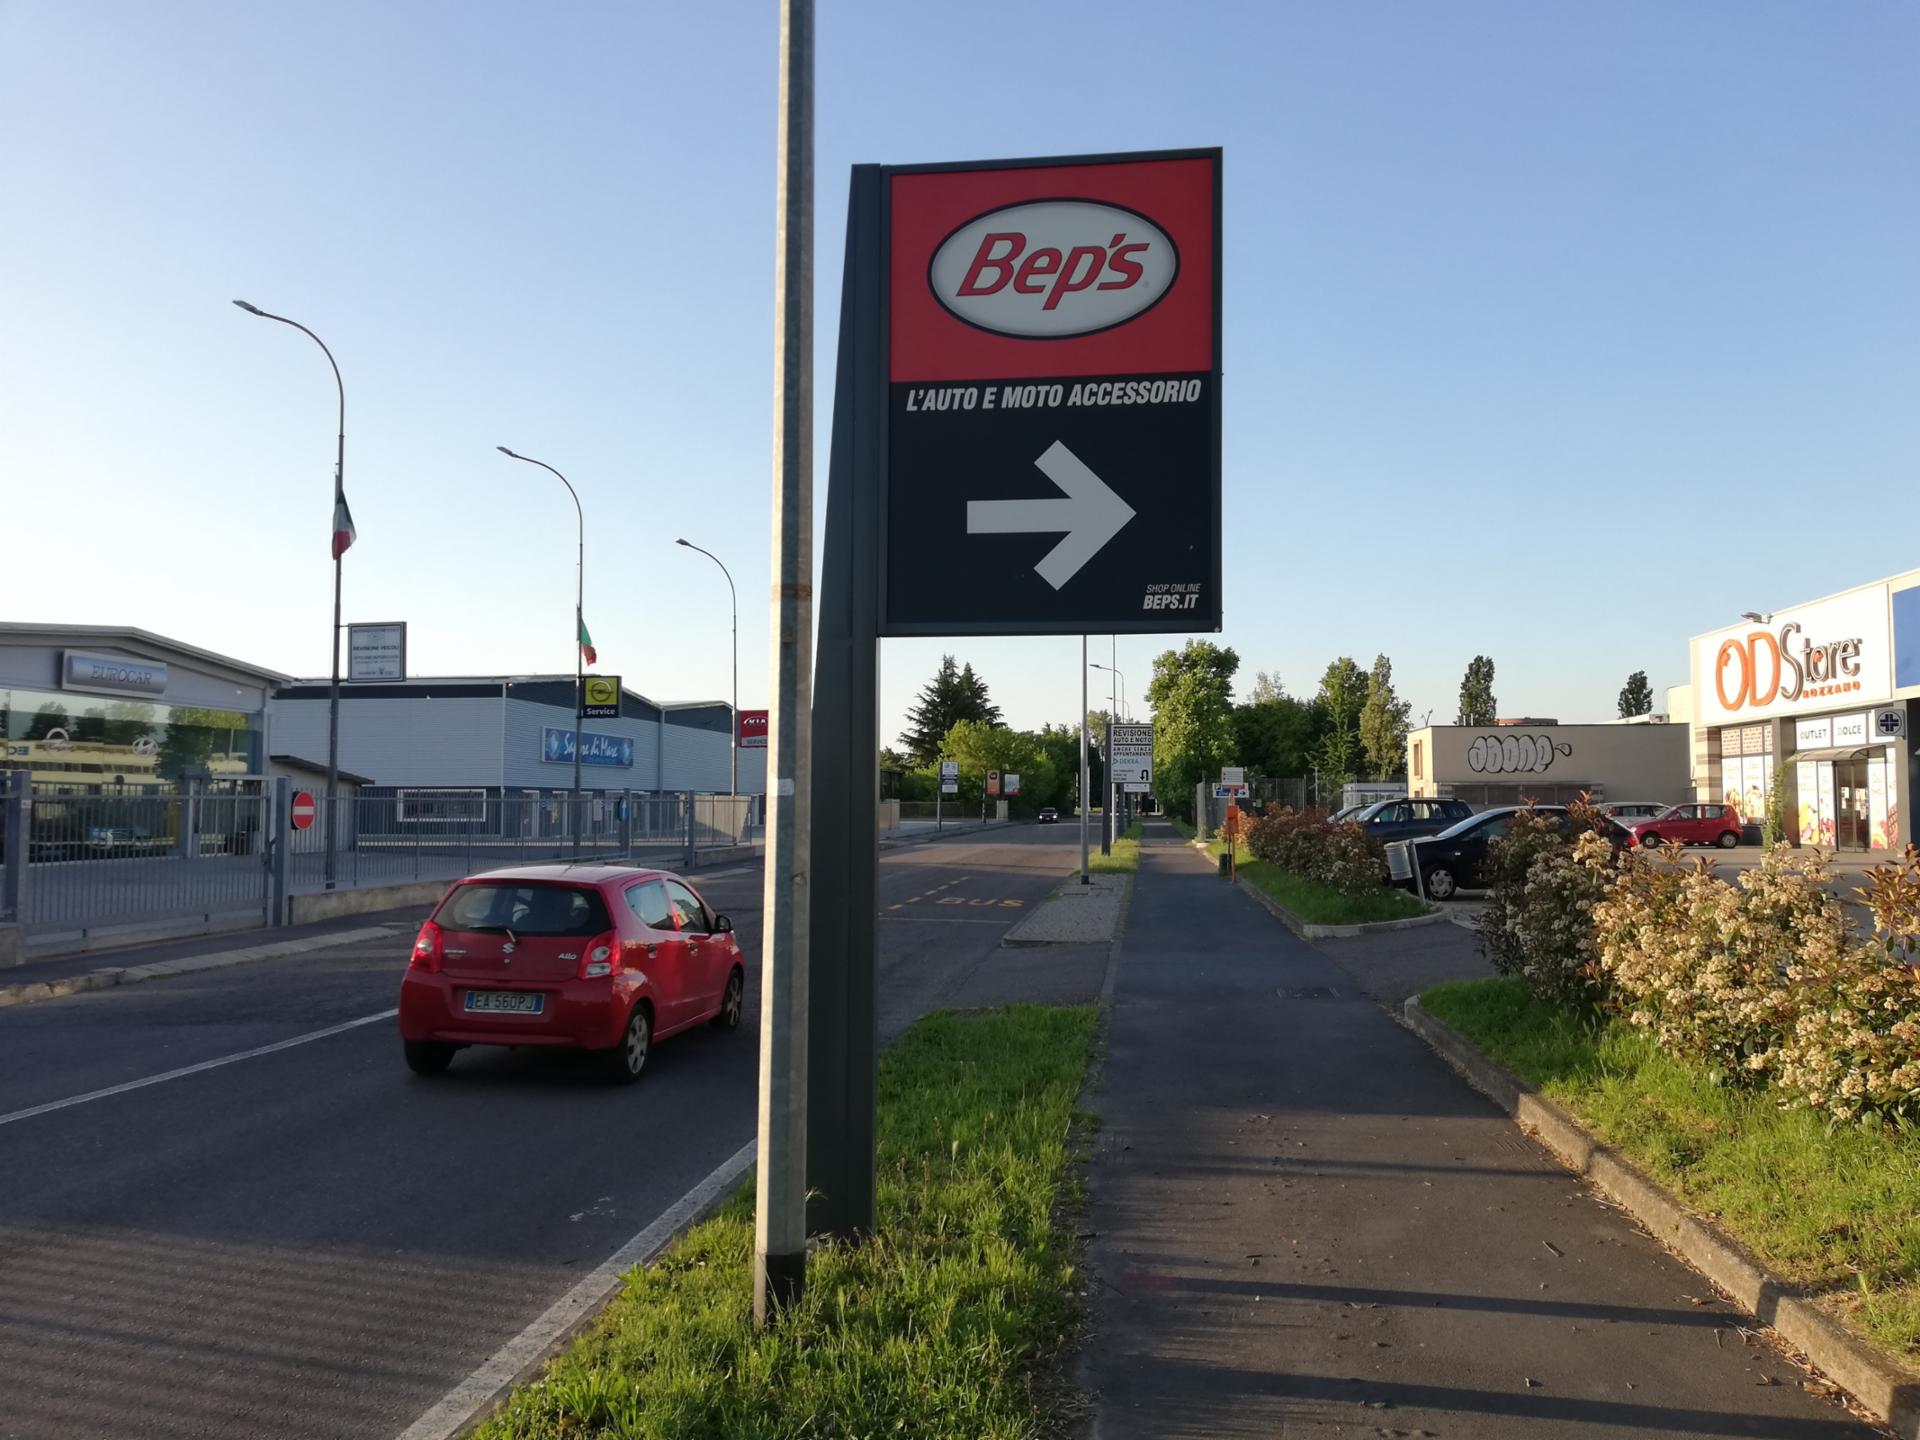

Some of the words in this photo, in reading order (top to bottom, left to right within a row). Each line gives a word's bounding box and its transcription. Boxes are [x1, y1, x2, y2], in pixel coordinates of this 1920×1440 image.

[956, 232, 1150, 310] Bep's
[906, 387, 979, 411] L'AUTO
[982, 387, 997, 409] E
[1001, 385, 1063, 408] MOTO
[1067, 379, 1202, 406] ACCESSORIO
[1146, 584, 1169, 593] SHOP
[1170, 583, 1201, 593] ONLINE
[1143, 594, 1199, 609] BEPS.IT
[90, 664, 152, 685] EUROCAR
[587, 707, 616, 715] Service
[1800, 729, 1827, 740] OUTLET
[1837, 725, 1862, 736] DOLCE
[936, 897, 1024, 907] BUS
[474, 994, 490, 1009] EA
